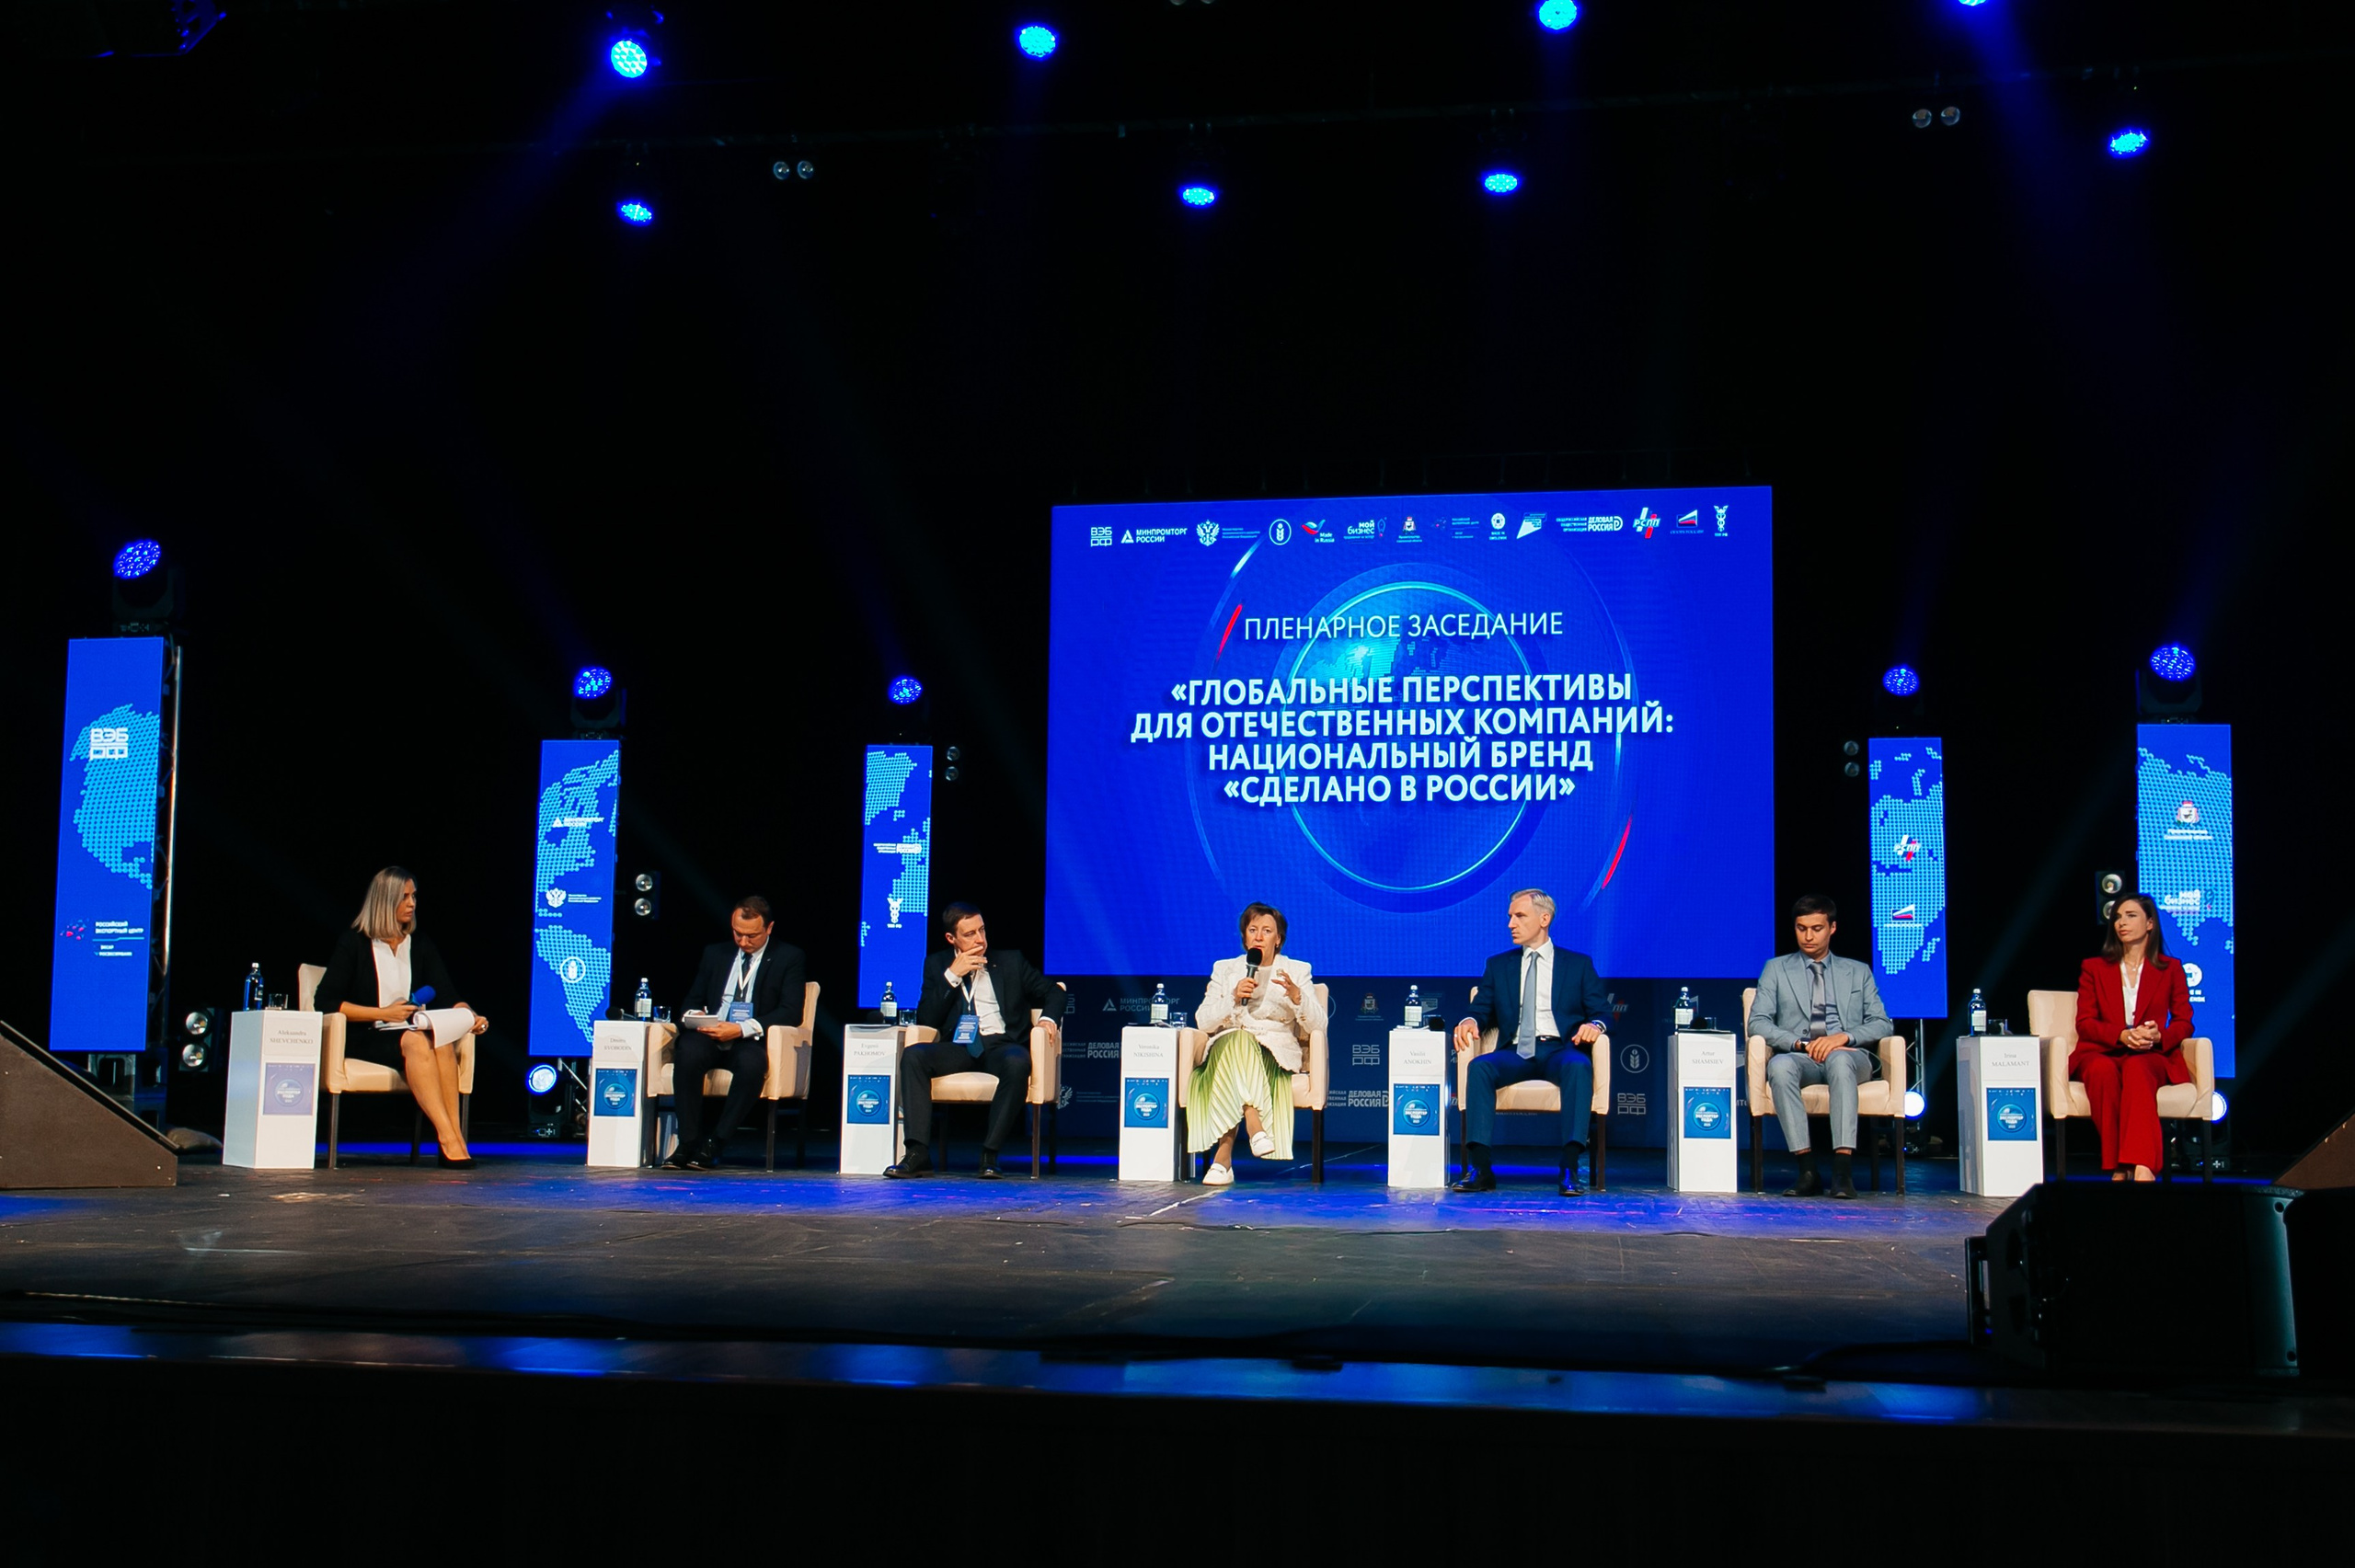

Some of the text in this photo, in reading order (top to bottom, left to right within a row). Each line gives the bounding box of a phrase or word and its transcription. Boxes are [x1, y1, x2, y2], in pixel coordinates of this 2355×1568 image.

[1136, 528, 1188, 536] МИНПРОМТОРГ
[1348, 525, 1375, 534] бизнес
[1588, 523, 1614, 532] РОССИЯ
[1245, 612, 1563, 640] ПЛЕНАРНОЕ ЗАСЕДАНИЕ
[1172, 674, 1632, 706] «ГЛОБАЛЬНЫЕ ПЕРСПЕКТИВЫ
[1132, 701, 1674, 742] ДЛЯ ОТЕЧЕСТВЕННЫХ КОМПАНИЙ:
[90, 727, 129, 743] ВЭБ
[1208, 737, 1594, 773] НАЦИОНАЛЬНЫЙ БРЕНД
[1224, 773, 1577, 807] «СДЕЛАНО В РОССИИ»
[1087, 1049, 1120, 1059] РОССИЯ
[1352, 1044, 1380, 1054] ВЭБ
[1348, 1090, 1382, 1098] ДЕЛОВАЯ
[1617, 1093, 1647, 1103] ВЭБ
[1348, 1098, 1382, 1107] РОССИЯ
